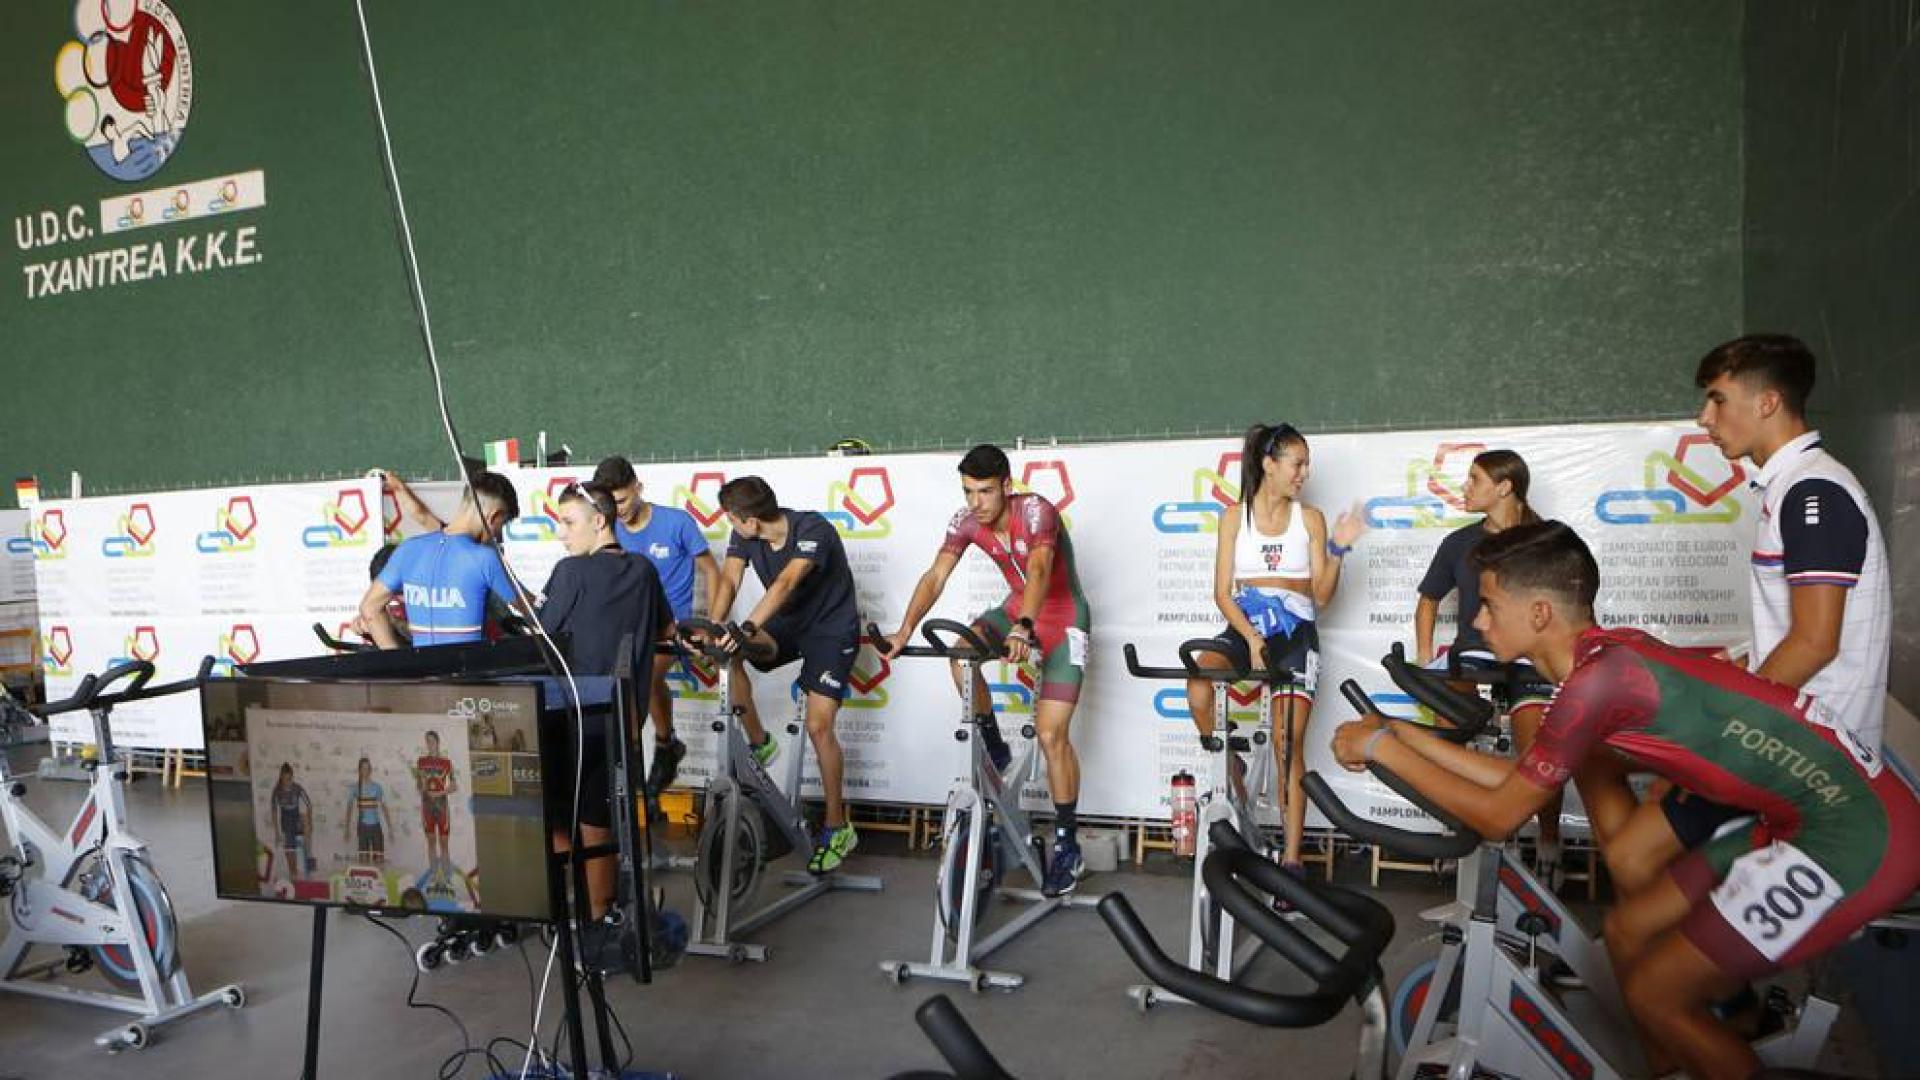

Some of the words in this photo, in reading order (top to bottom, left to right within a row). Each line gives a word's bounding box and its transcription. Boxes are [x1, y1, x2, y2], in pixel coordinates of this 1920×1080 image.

[16, 205, 94, 250] U.D.C.
[24, 241, 167, 299] TXANTREA
[176, 226, 263, 274] K.K.E.
[1743, 864, 1825, 941] 300
